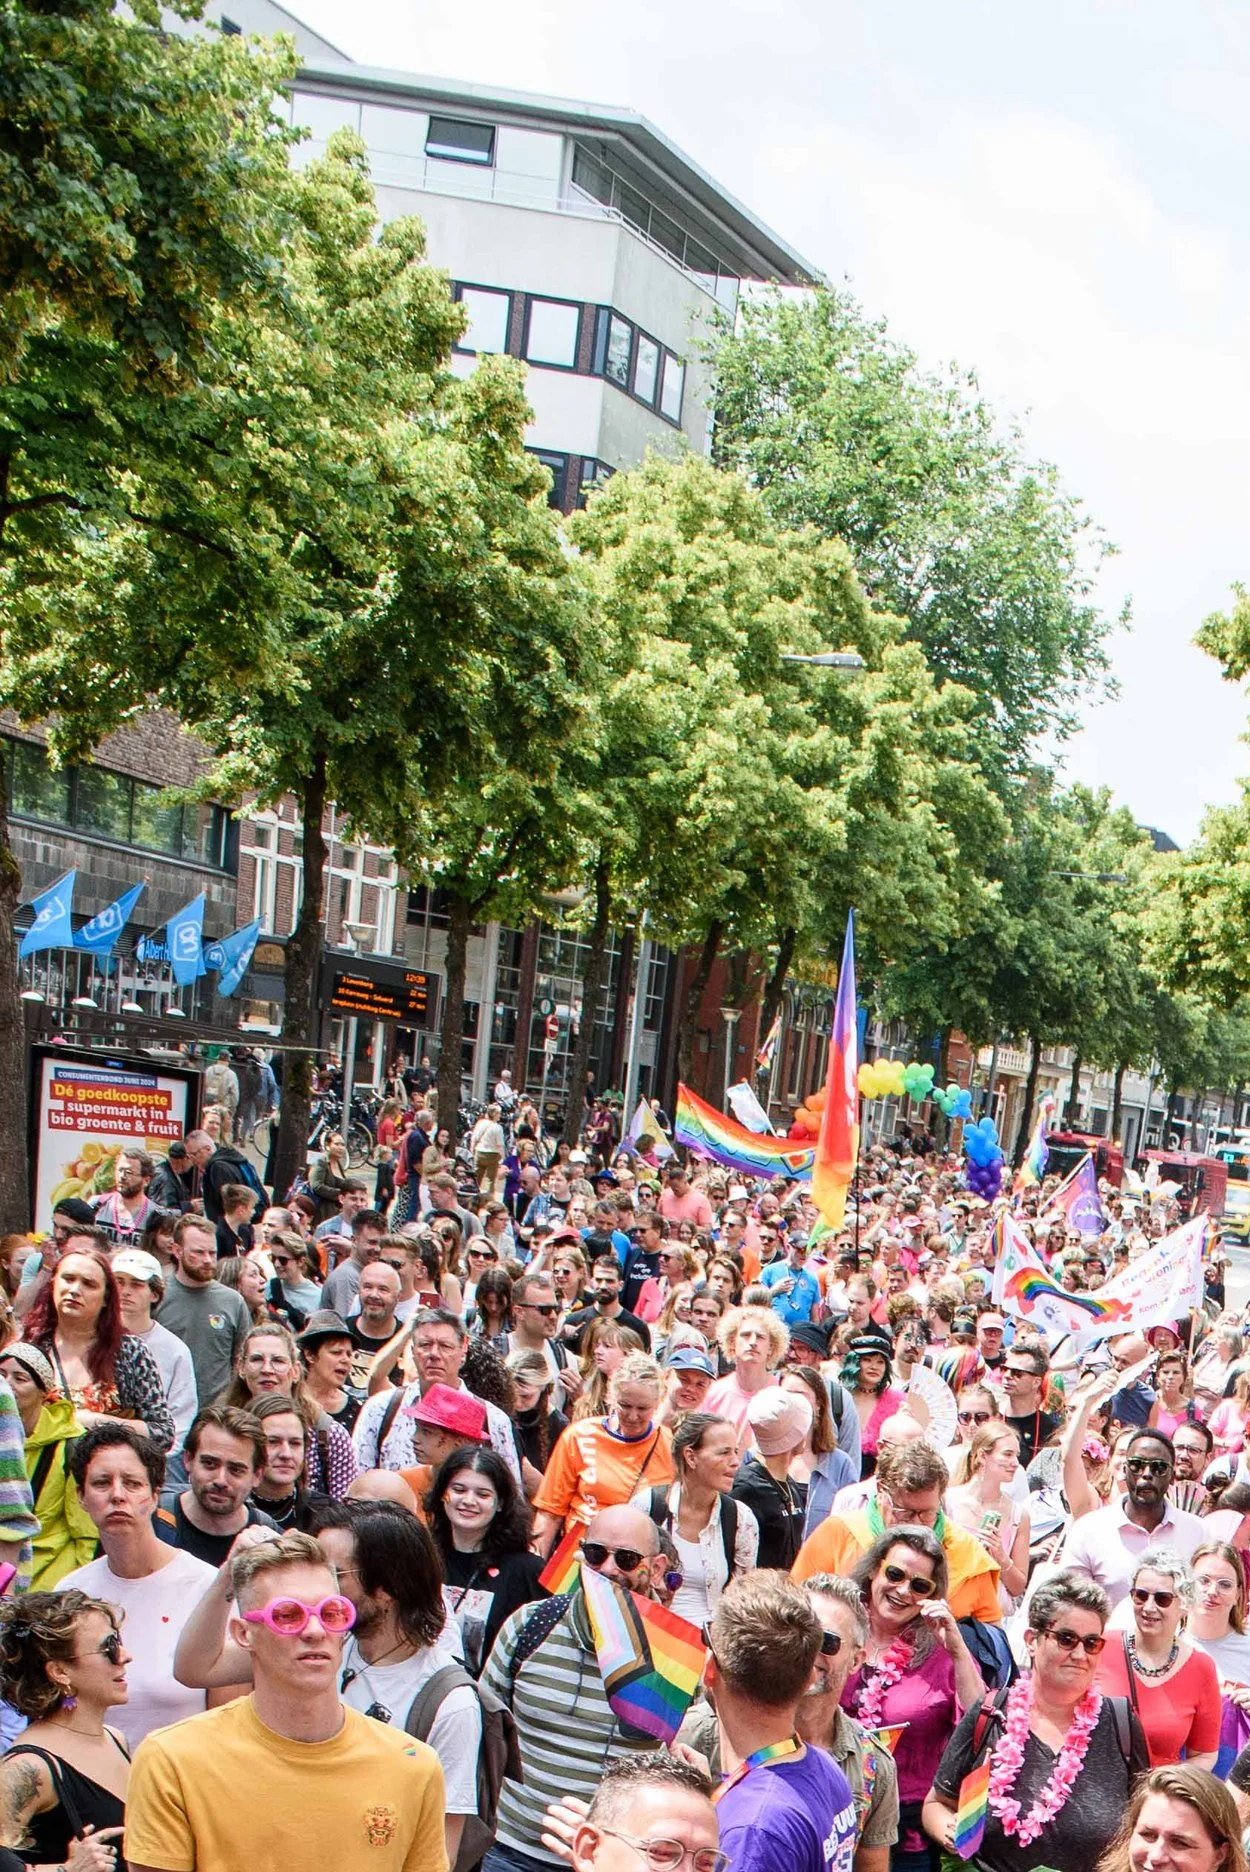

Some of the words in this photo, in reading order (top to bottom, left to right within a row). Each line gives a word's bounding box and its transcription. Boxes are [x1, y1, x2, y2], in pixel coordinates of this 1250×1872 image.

[53, 1083, 74, 1096] Dé
[76, 1087, 168, 1106] goedkoopste
[67, 1101, 148, 1119] supermarkt
[150, 1106, 164, 1120] in
[51, 1112, 74, 1126] bio
[76, 1116, 132, 1131] groente
[134, 1120, 146, 1132] &
[147, 1121, 179, 1136] fruit
